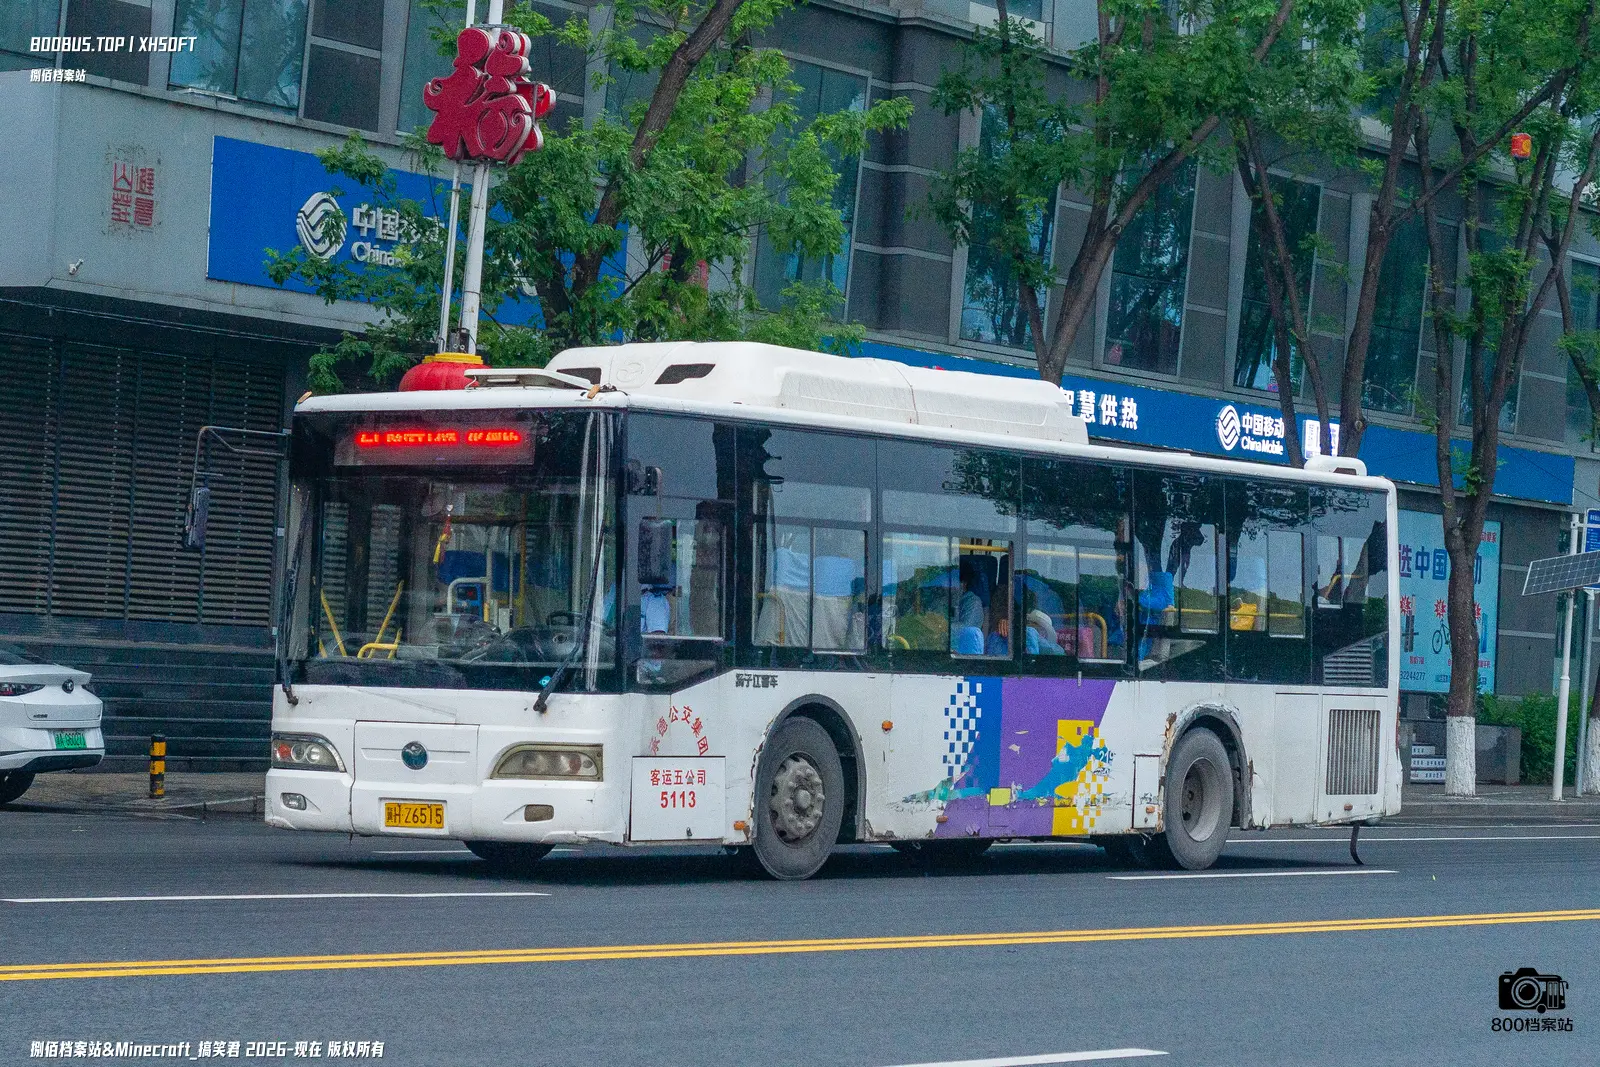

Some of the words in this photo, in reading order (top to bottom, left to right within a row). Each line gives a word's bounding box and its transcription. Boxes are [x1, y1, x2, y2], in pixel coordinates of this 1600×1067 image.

[1242, 412, 1285, 439] 中国移动
[1241, 435, 1262, 453] China
[1261, 439, 1284, 456] Mobile
[650, 769, 706, 786] 客运五公司
[660, 790, 697, 809] 5113
